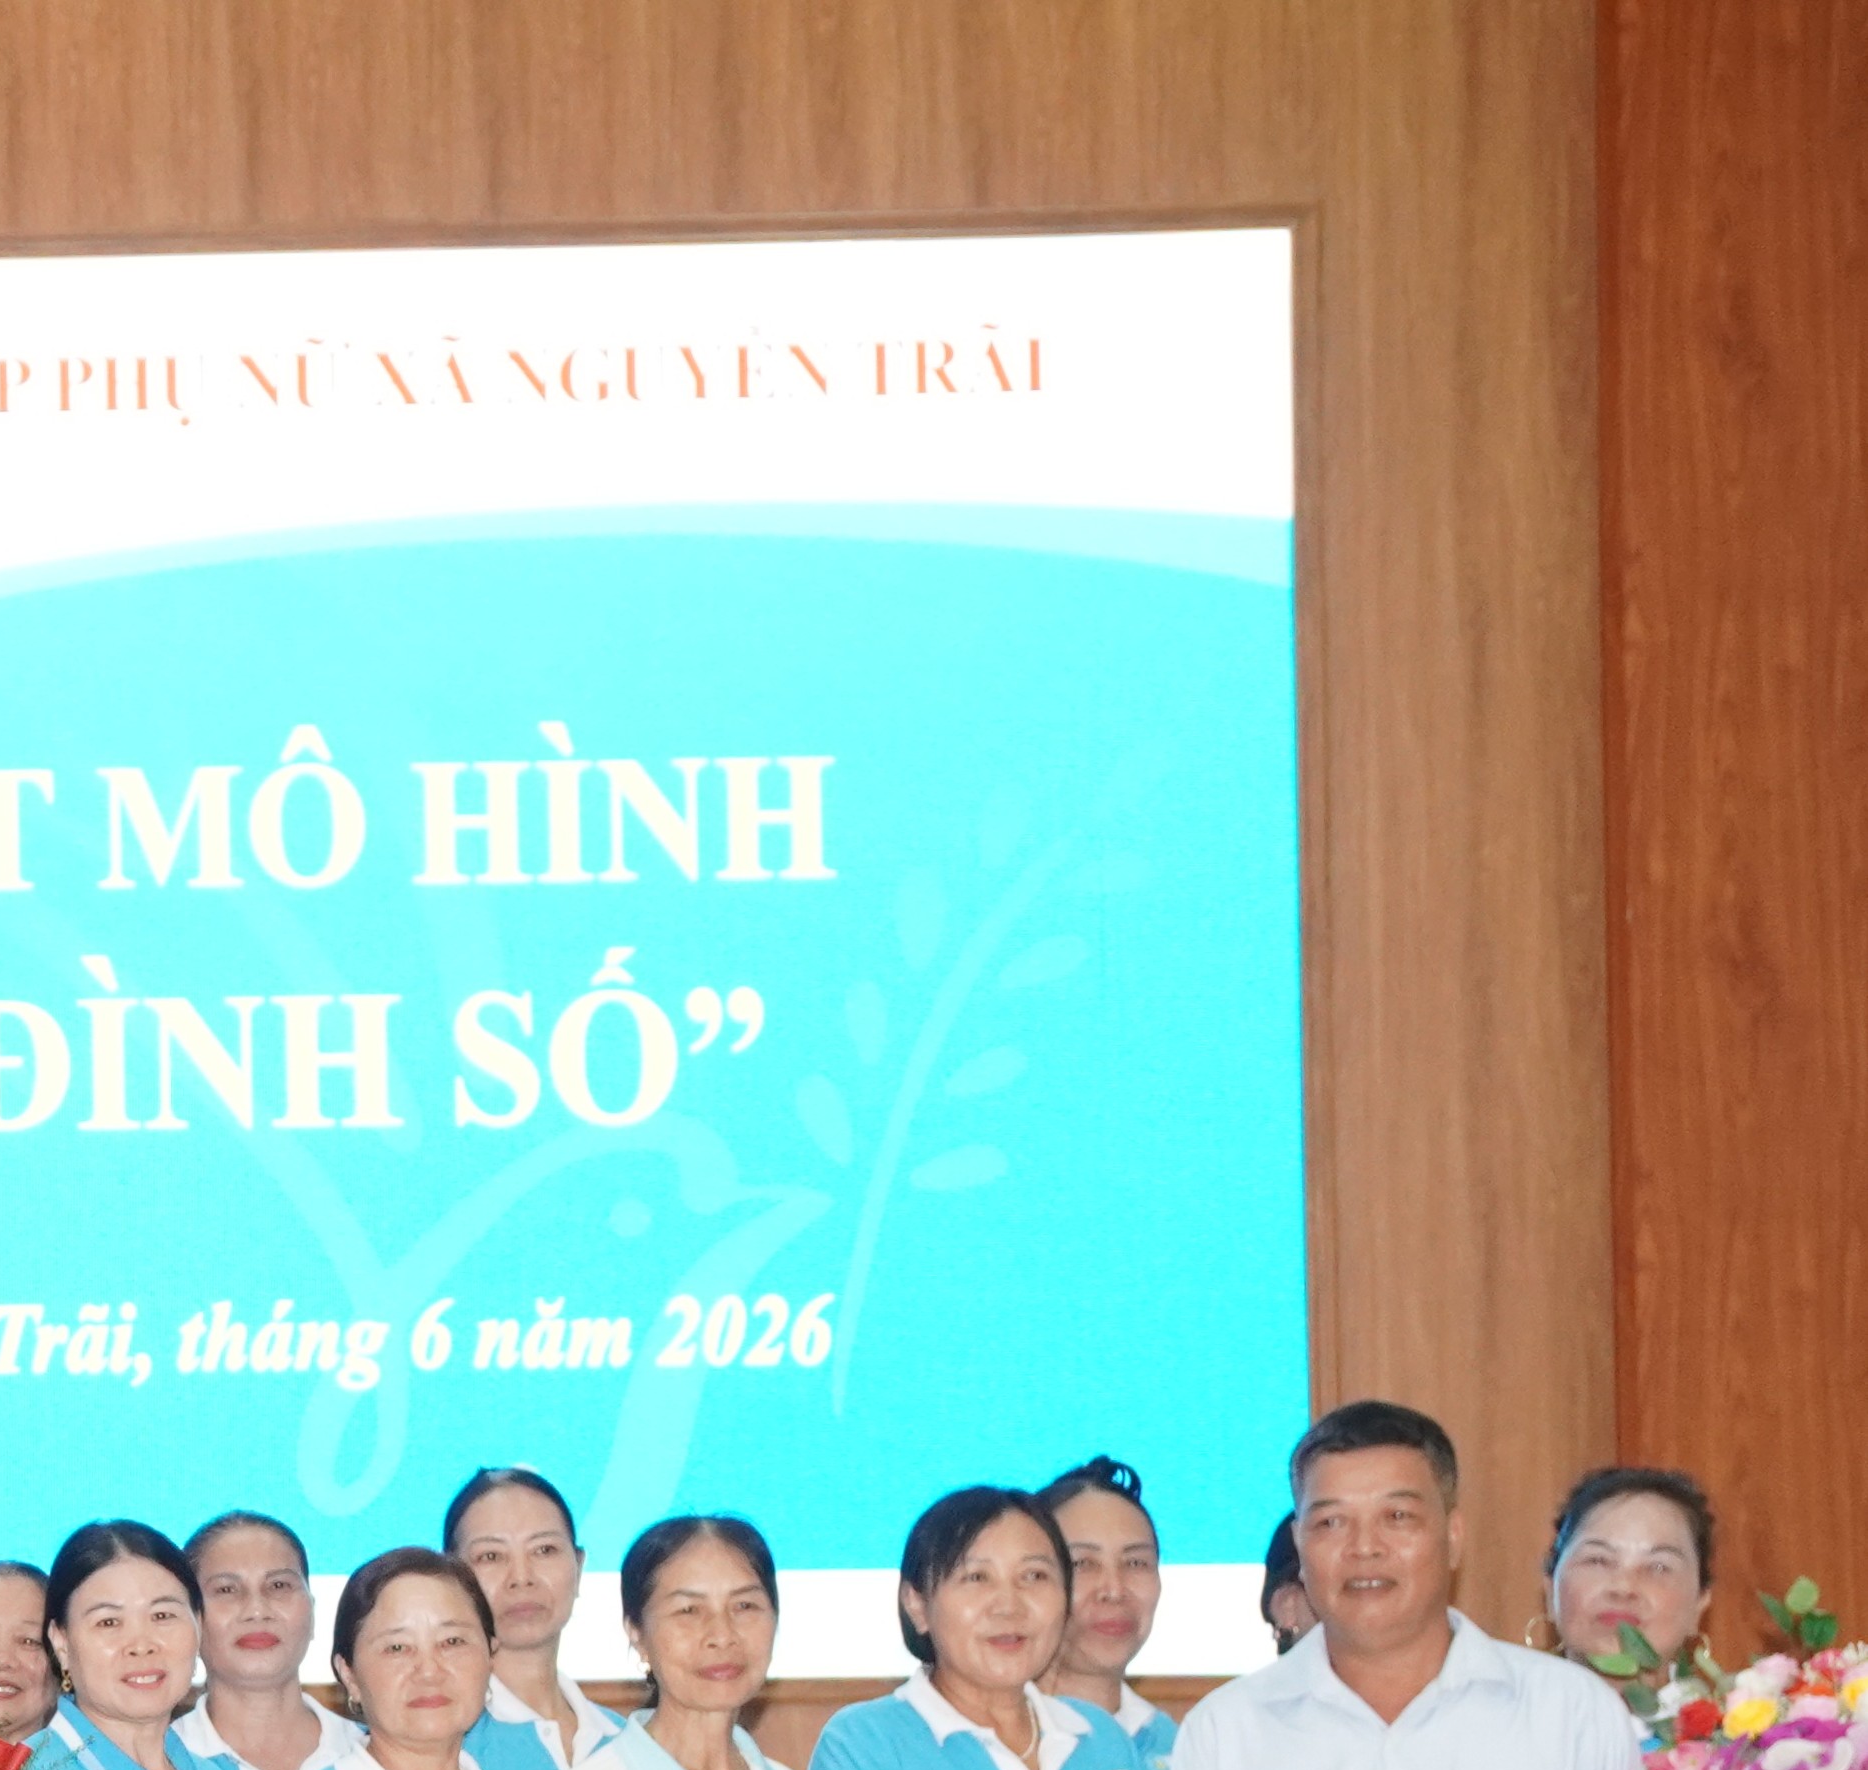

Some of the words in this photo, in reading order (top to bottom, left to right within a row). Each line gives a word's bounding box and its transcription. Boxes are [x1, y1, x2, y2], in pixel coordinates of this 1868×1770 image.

[56, 356, 205, 428] PHỤ
[374, 334, 477, 407] XÃ
[861, 321, 1044, 398] TRÃI
[97, 724, 367, 892] MÔ
[412, 721, 837, 888] HÌNH
[177, 1299, 392, 1393] tháng
[411, 1298, 455, 1372] 6
[474, 1298, 634, 1371] năm
[656, 1293, 835, 1369] 2026
